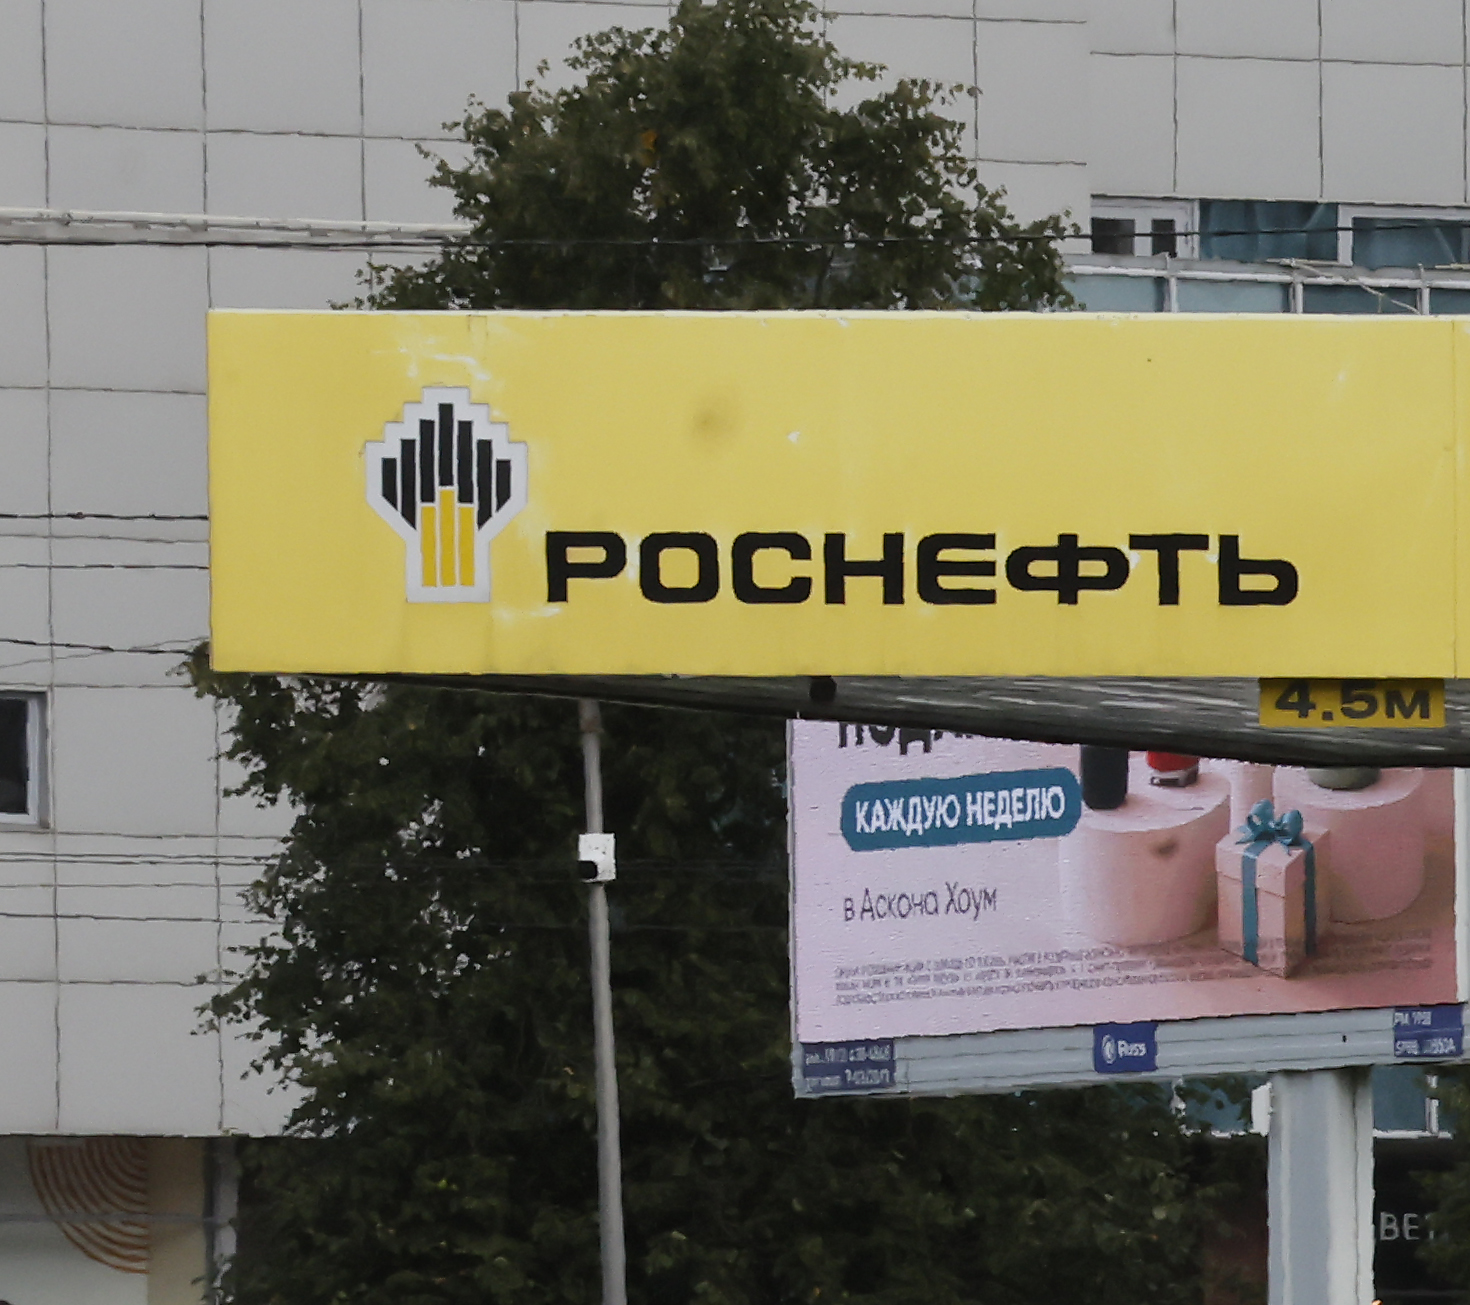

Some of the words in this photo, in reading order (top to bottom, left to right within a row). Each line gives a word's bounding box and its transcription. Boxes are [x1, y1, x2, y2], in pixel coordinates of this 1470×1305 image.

[545, 531, 1299, 606] РОСНЕФТЬ
[855, 794, 961, 836] КАЖДУЮ
[966, 785, 1066, 831] НЕДЕЛЮ
[844, 897, 855, 922] в
[860, 887, 940, 921] Аскона
[945, 881, 997, 921] Хоум
